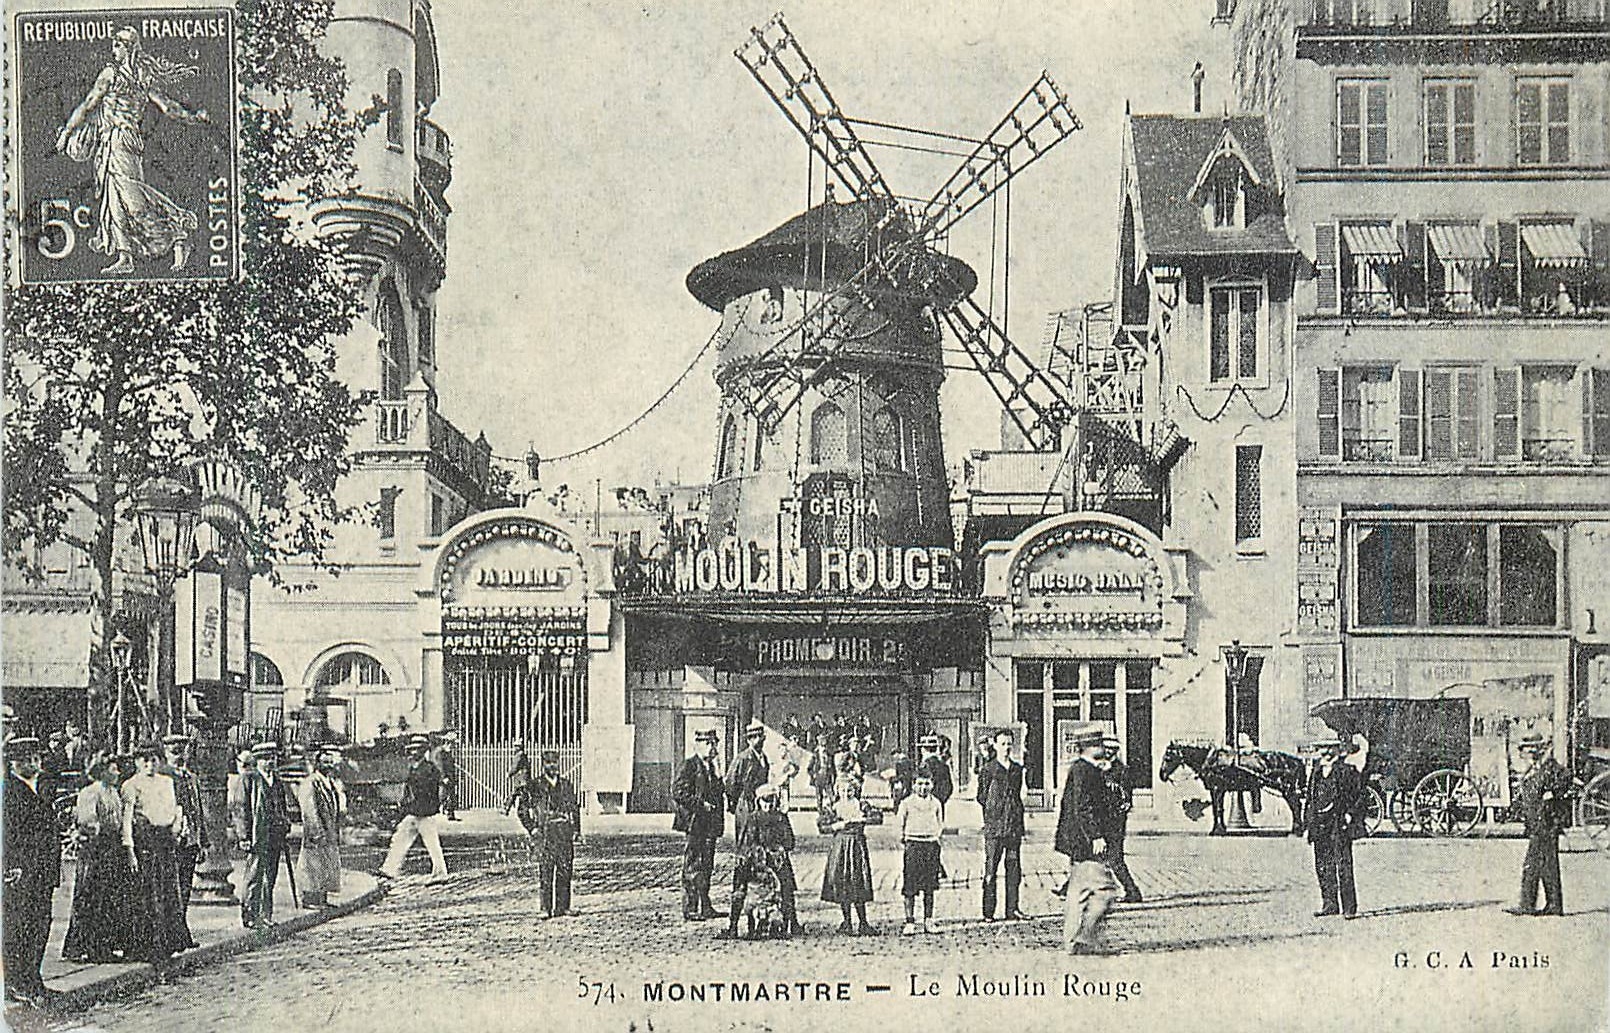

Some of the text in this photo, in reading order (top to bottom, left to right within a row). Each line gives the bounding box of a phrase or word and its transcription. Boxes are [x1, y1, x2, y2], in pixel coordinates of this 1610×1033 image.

[141, 18, 227, 40] FRANÇAISE
[208, 176, 229, 268] POSTES
[809, 497, 879, 516] GEISHA
[674, 544, 952, 593] MOULIN ROUGE
[539, 621, 582, 631] JARDINS
